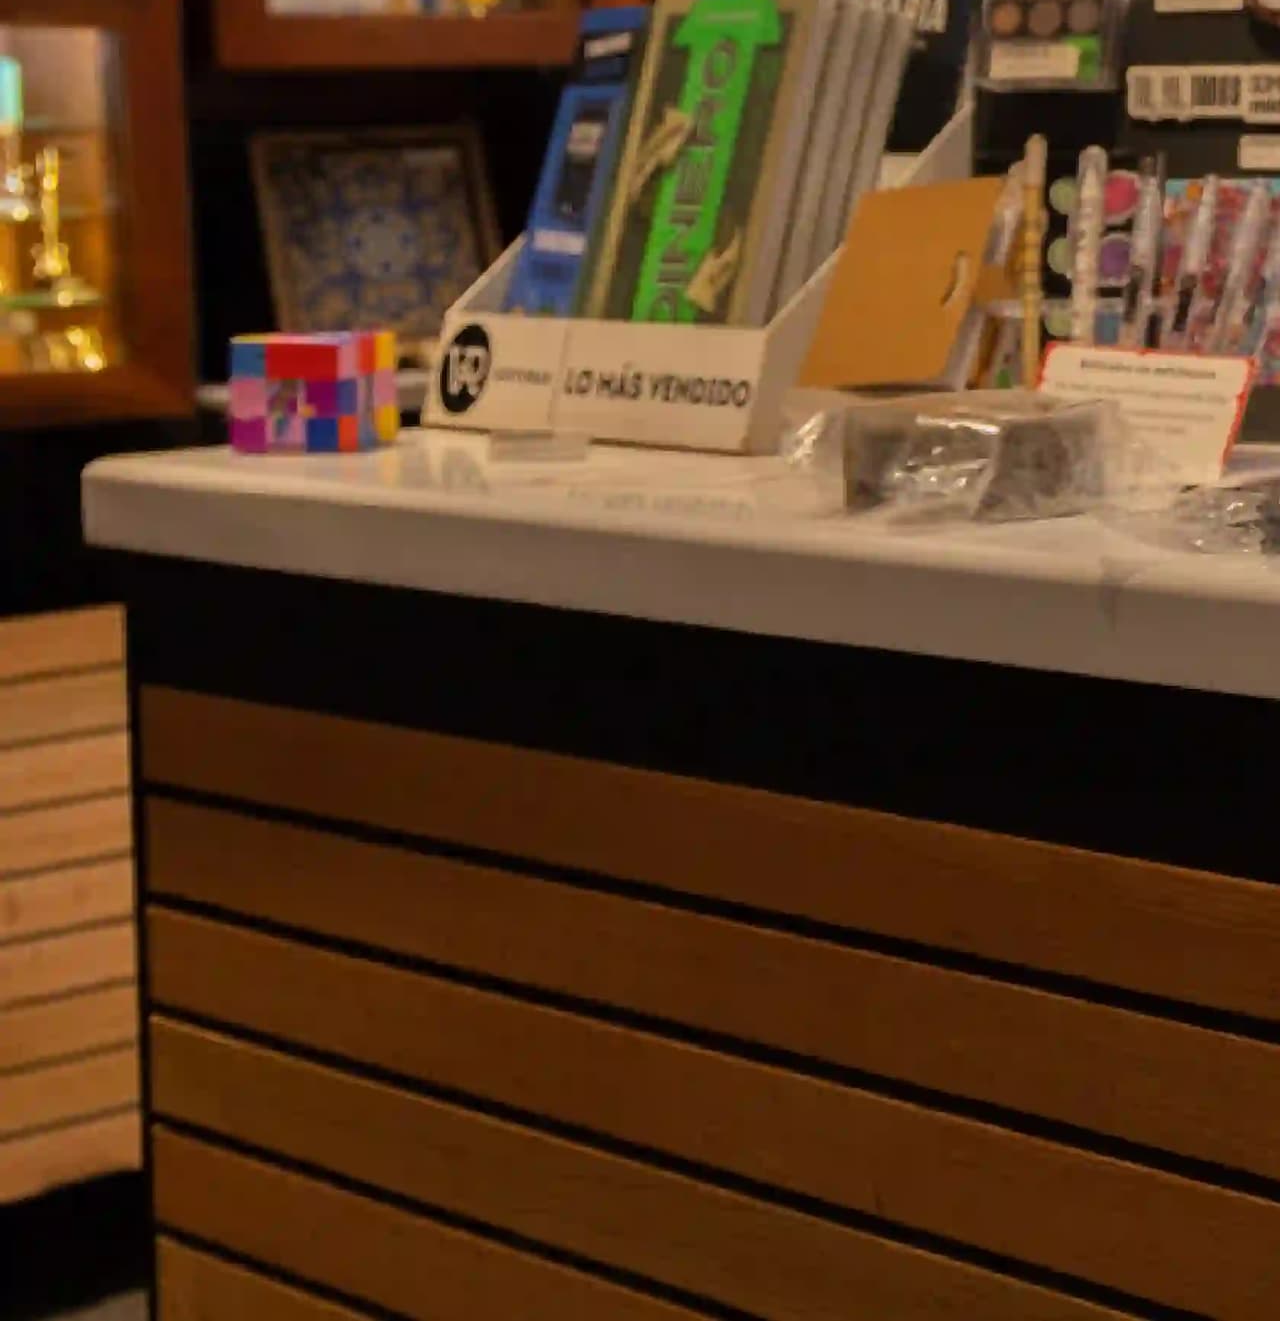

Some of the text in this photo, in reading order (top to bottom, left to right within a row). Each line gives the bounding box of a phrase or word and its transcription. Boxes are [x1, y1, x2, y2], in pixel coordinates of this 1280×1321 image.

[563, 369, 593, 395] LO
[595, 361, 642, 400] MÁS
[650, 373, 751, 408] VENDIDO
